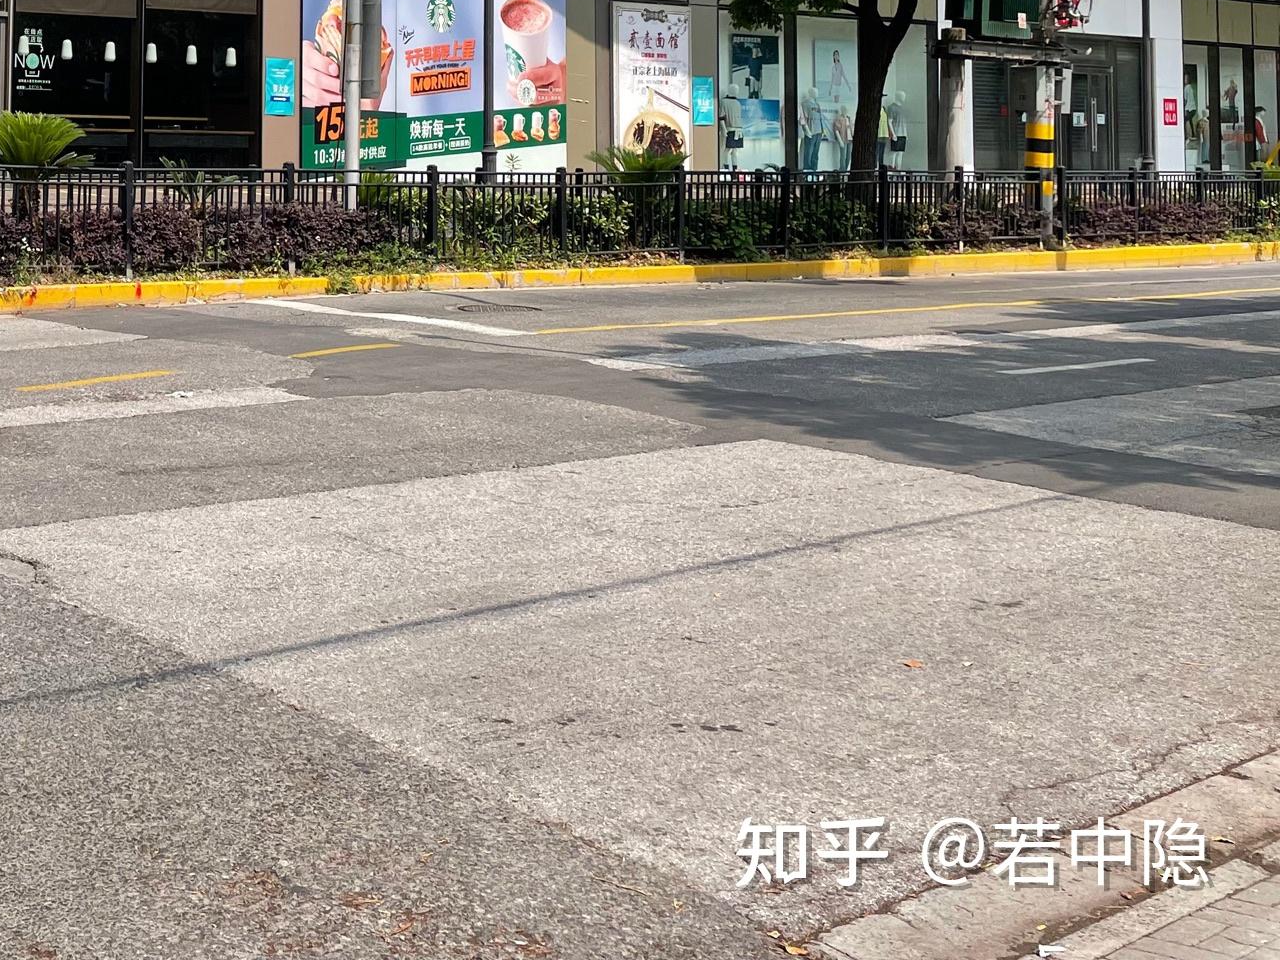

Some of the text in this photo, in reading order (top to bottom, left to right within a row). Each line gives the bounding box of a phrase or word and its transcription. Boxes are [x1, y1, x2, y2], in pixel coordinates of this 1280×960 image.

[413, 71, 468, 92] MORNING!
[1165, 102, 1176, 111] UNI
[1165, 113, 1176, 123] QLO
[410, 117, 466, 140] 焕新每一天
